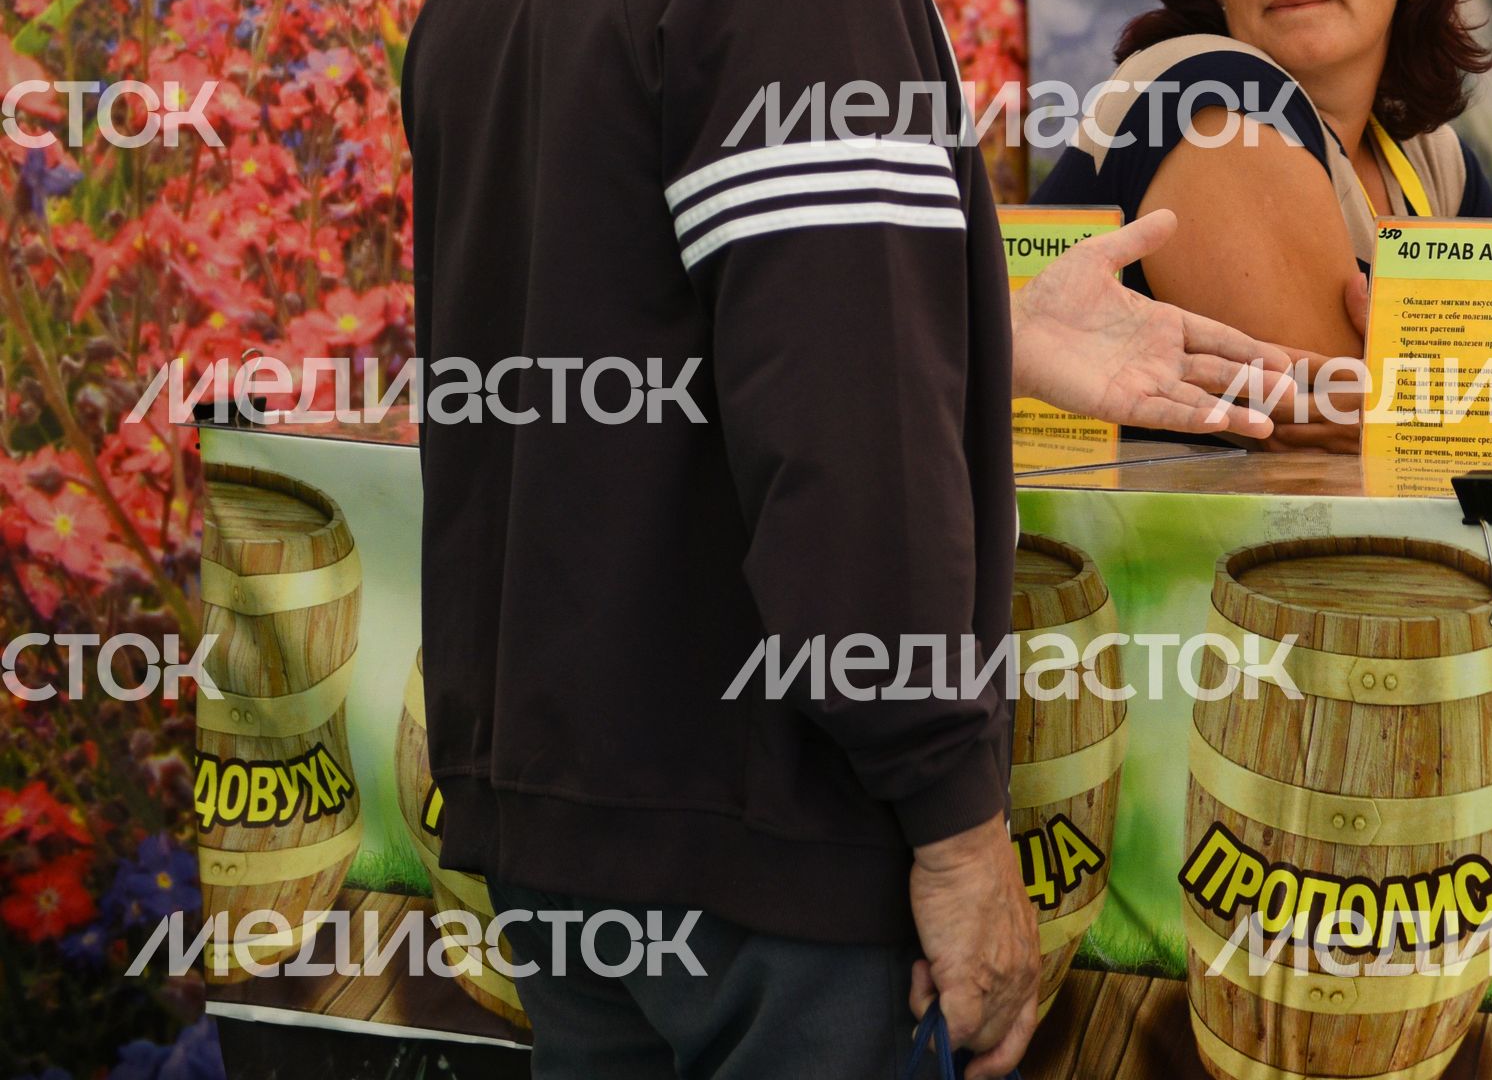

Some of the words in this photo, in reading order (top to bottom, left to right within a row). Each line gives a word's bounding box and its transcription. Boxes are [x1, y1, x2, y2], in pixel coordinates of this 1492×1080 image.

[1379, 228, 1402, 240] 350
[1398, 241, 1420, 259] 40
[1426, 242, 1474, 260] ТРАВ
[1403, 297, 1438, 306] Обладает
[1430, 326, 1465, 334] растений
[1400, 338, 1451, 347] Чрезвычайно
[1395, 447, 1422, 455] Чистит
[195, 746, 352, 829] ДОВУХА
